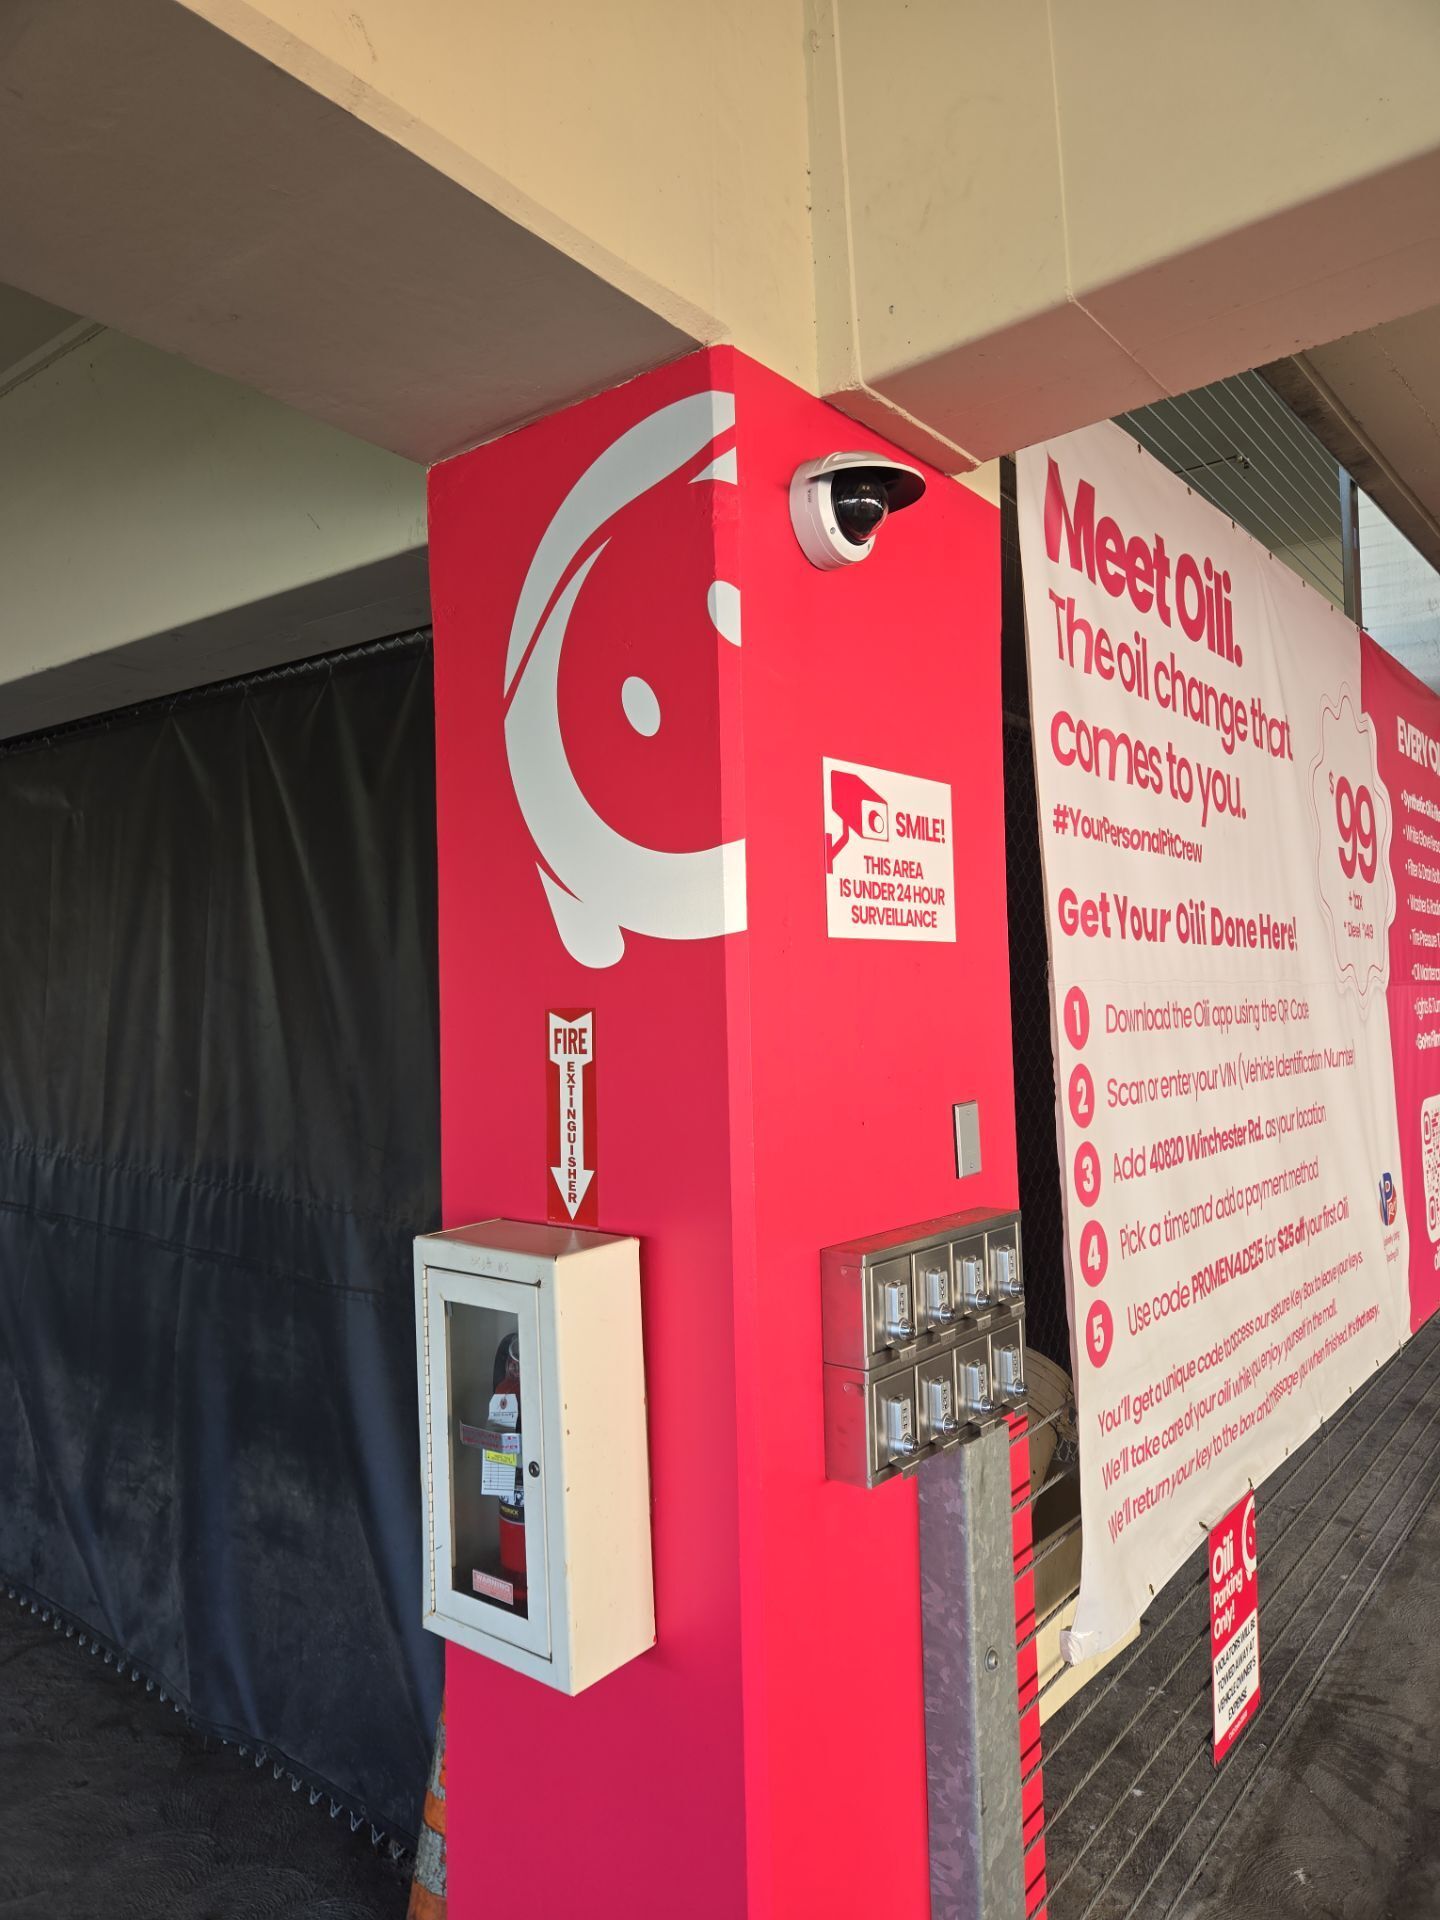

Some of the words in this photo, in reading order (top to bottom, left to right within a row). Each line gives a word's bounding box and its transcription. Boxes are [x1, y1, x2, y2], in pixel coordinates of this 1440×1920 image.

[1044, 453, 1171, 628] Meet
[1175, 553, 1243, 667] Oili.
[1049, 588, 1115, 681] The
[1117, 630, 1150, 700] oil
[1153, 652, 1248, 755] change
[1250, 698, 1293, 761] that
[1050, 711, 1163, 795] comes
[1166, 741, 1193, 803] to
[1196, 763, 1247, 828] you.
[1397, 715, 1428, 768] EVERY
[895, 811, 946, 844] SMILE!
[1053, 804, 1202, 863] #YourPersonalPitCrew
[839, 878, 852, 898] IS
[853, 880, 896, 902] UNDER
[897, 883, 911, 903] 24
[913, 886, 945, 906] HOUR
[864, 855, 891, 876] THIS
[893, 859, 924, 880] AREA
[851, 904, 938, 929] SURVEILLANCE
[1058, 888, 1111, 938] Get
[1113, 894, 1171, 942] Your
[1176, 899, 1207, 945] Oili
[1211, 907, 1257, 948] Done
[1259, 914, 1297, 951] Here!
[1353, 890, 1363, 911] tax
[554, 1028, 588, 1055] FIRE
[1073, 1000, 1082, 1036] 1
[1106, 1001, 1171, 1033] Download
[1172, 1001, 1192, 1028] the
[1194, 999, 1210, 1027] Oili
[1212, 1005, 1232, 1034] app
[1234, 998, 1260, 1031] using
[1261, 998, 1276, 1022] the
[1277, 999, 1289, 1024] QR
[1290, 997, 1309, 1020] Code
[1076, 1078, 1089, 1115] 2
[1107, 1078, 1147, 1108] Scan
[1148, 1077, 1159, 1101] or
[1161, 1069, 1191, 1098] enter
[1192, 1067, 1218, 1102] your
[1219, 1061, 1237, 1087] VIN
[1238, 1052, 1274, 1090] (Vehicle
[1275, 1049, 1322, 1079] Identification
[566, 1061, 577, 1203] EXTINGUISHER
[1082, 1155, 1094, 1192] 3
[1113, 1146, 1146, 1183] Add
[1150, 1135, 1184, 1173] 40820
[1186, 1123, 1247, 1161] Winchester
[1248, 1116, 1264, 1143] Rd.
[1265, 1119, 1276, 1139] as
[1275, 1112, 1295, 1143] your
[1296, 1101, 1327, 1130] location
[1087, 1234, 1101, 1270] 4
[1119, 1220, 1147, 1260] Pick
[1150, 1222, 1161, 1247] a
[1164, 1210, 1190, 1242] time
[1190, 1194, 1212, 1229] and
[1215, 1186, 1236, 1220] add
[1237, 1190, 1244, 1210] a
[1245, 1170, 1288, 1216] payment
[1288, 1155, 1319, 1190] method
[1093, 1314, 1105, 1352] 5
[1127, 1302, 1151, 1336] Use
[1153, 1281, 1190, 1320] code
[1191, 1238, 1264, 1304] PROMENADE25
[1264, 1234, 1277, 1261] for
[1277, 1223, 1294, 1254] $25
[1295, 1216, 1305, 1243] off
[1305, 1213, 1322, 1247] your
[1322, 1205, 1337, 1230] first
[1098, 1394, 1130, 1437] You'll
[1133, 1384, 1154, 1425] get
[1155, 1382, 1162, 1403] a
[1162, 1364, 1196, 1393] unique
[1198, 1342, 1224, 1373] code
[1223, 1338, 1231, 1358] to
[1230, 1320, 1254, 1353] access
[1255, 1311, 1271, 1332] our
[1270, 1297, 1290, 1324] secure
[1290, 1288, 1303, 1309] Key
[1304, 1280, 1315, 1300] Box
[1320, 1270, 1336, 1288] leave
[1102, 1447, 1128, 1490] We'll
[1131, 1436, 1160, 1468] take
[1162, 1418, 1184, 1449] care
[1184, 1402, 1194, 1430] of
[1193, 1393, 1216, 1431] your
[1217, 1378, 1231, 1406] oili
[1232, 1366, 1252, 1397] while
[1250, 1356, 1261, 1388] you
[1261, 1342, 1283, 1370] enjoy
[1282, 1319, 1306, 1361] yourself
[1306, 1317, 1313, 1335] in
[1312, 1312, 1322, 1331] the
[1108, 1497, 1131, 1544] We'll
[1132, 1477, 1170, 1519] return
[1169, 1457, 1195, 1498] your
[1195, 1442, 1213, 1472] key
[1212, 1435, 1222, 1456] to
[1222, 1423, 1238, 1447] the
[1240, 1410, 1256, 1436] box
[1256, 1391, 1272, 1422] and
[1270, 1371, 1298, 1406] message
[1299, 1359, 1309, 1389] you
[1309, 1349, 1325, 1371] when
[1212, 1529, 1234, 1584] Oili
[1213, 1567, 1243, 1614] Parking
[1213, 1599, 1235, 1640] Only!
[1215, 1636, 1240, 1675] VIOLATORS
[1241, 1623, 1250, 1642] WILL
[1218, 1664, 1235, 1693] TOWED
[1235, 1644, 1249, 1669] AWAY
[1249, 1636, 1255, 1652] AT
[1218, 1682, 1236, 1713] VEHICLE
[1228, 1686, 1247, 1720] EXPENSE
